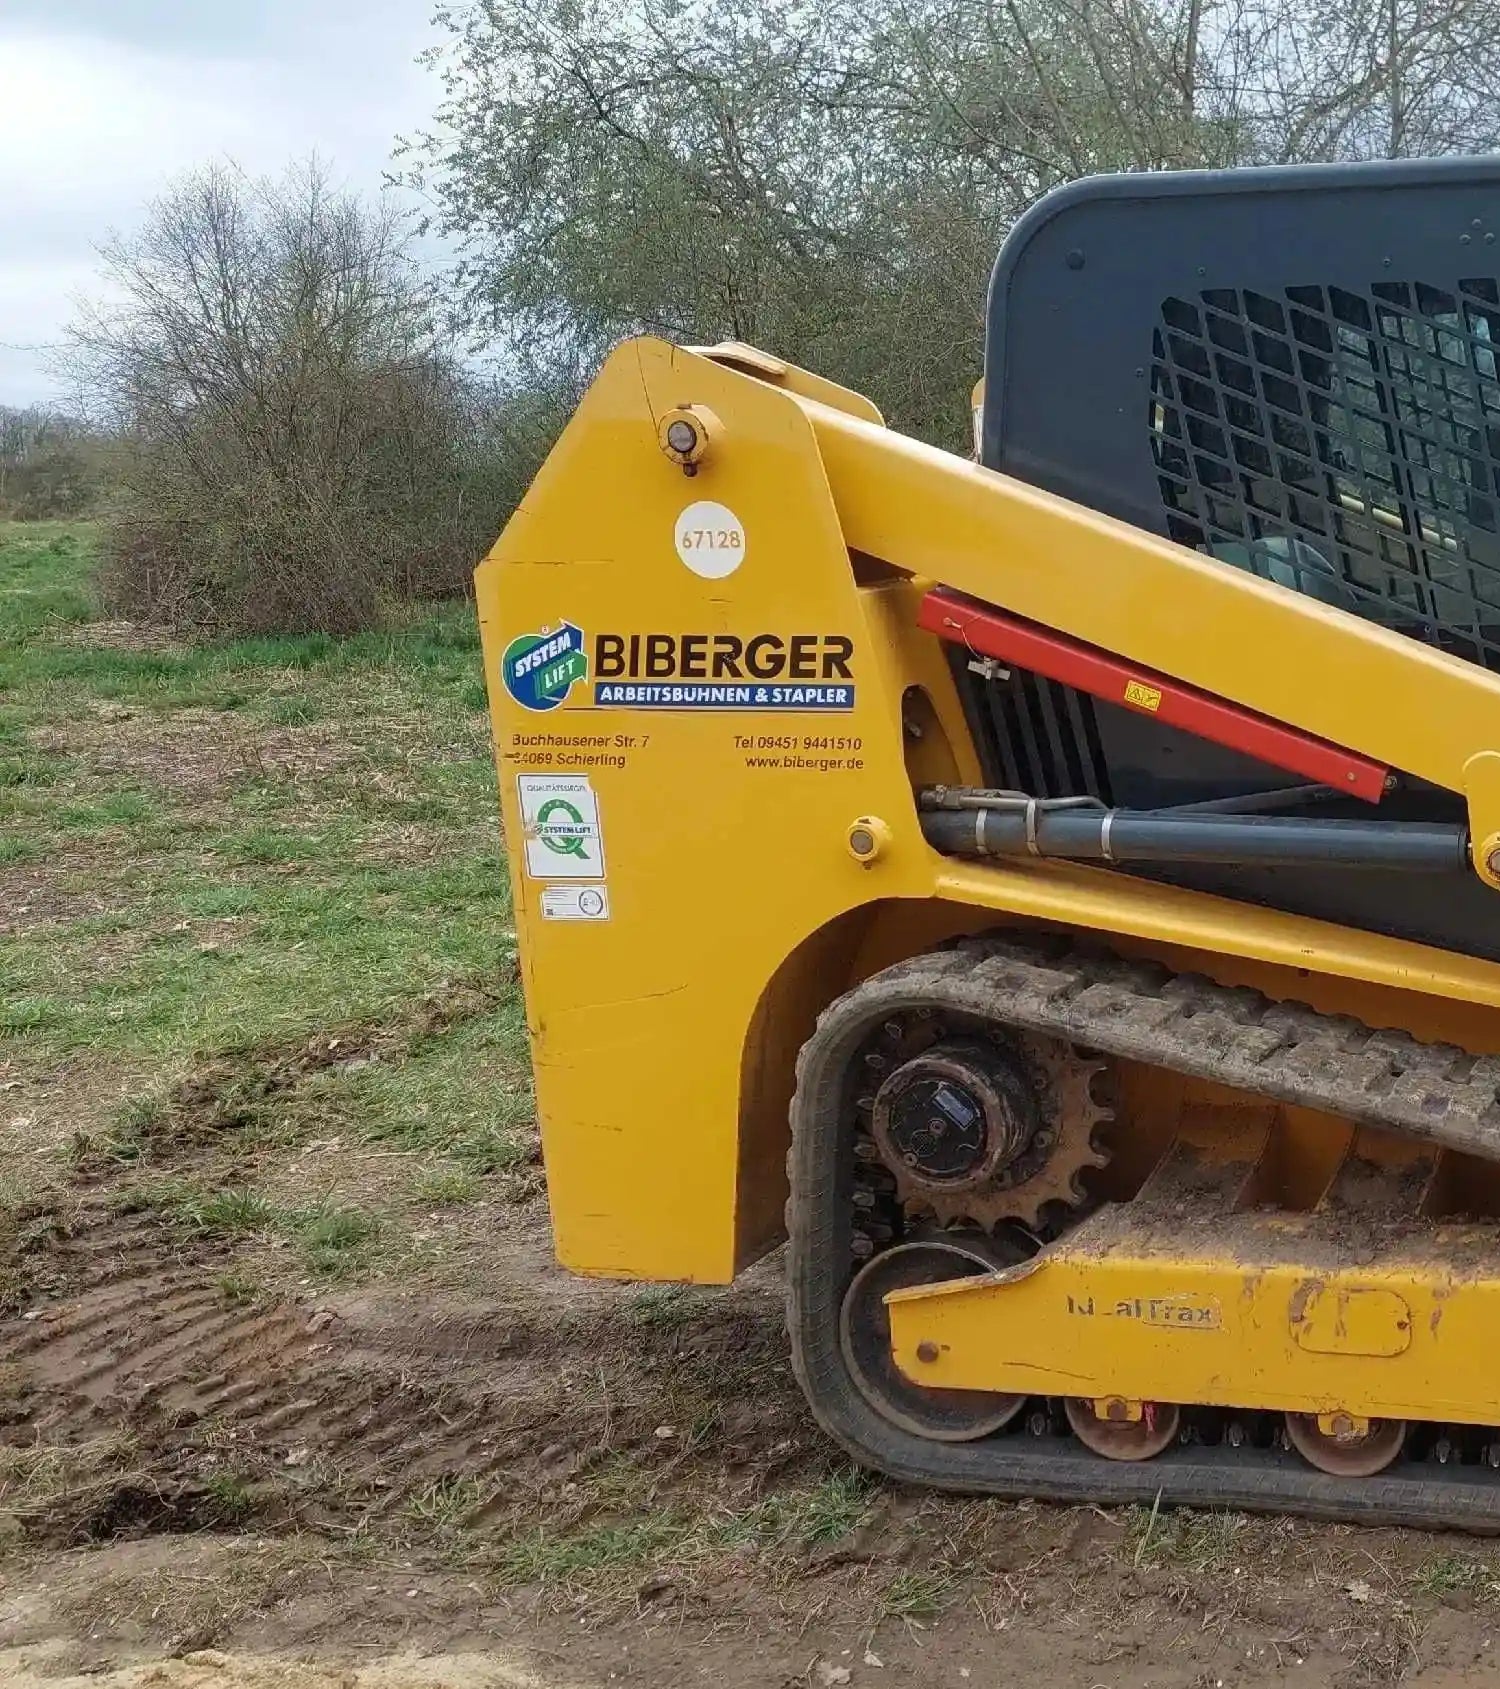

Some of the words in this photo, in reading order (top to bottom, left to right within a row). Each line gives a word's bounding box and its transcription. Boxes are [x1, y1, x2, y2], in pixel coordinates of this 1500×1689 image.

[682, 530, 741, 548] 67128
[514, 631, 572, 678] SYSTEM
[595, 634, 854, 679] BIBERGER
[544, 658, 575, 689] LIFT
[754, 687, 769, 702] &
[772, 688, 847, 703] STAPLER
[512, 734, 610, 748] Buchhausener
[614, 735, 637, 747] Str.
[642, 736, 650, 747] 7
[758, 737, 798, 749] 09451
[803, 737, 862, 750] 9441510
[556, 753, 626, 768] Schierling
[745, 756, 864, 771] www.biberger.de
